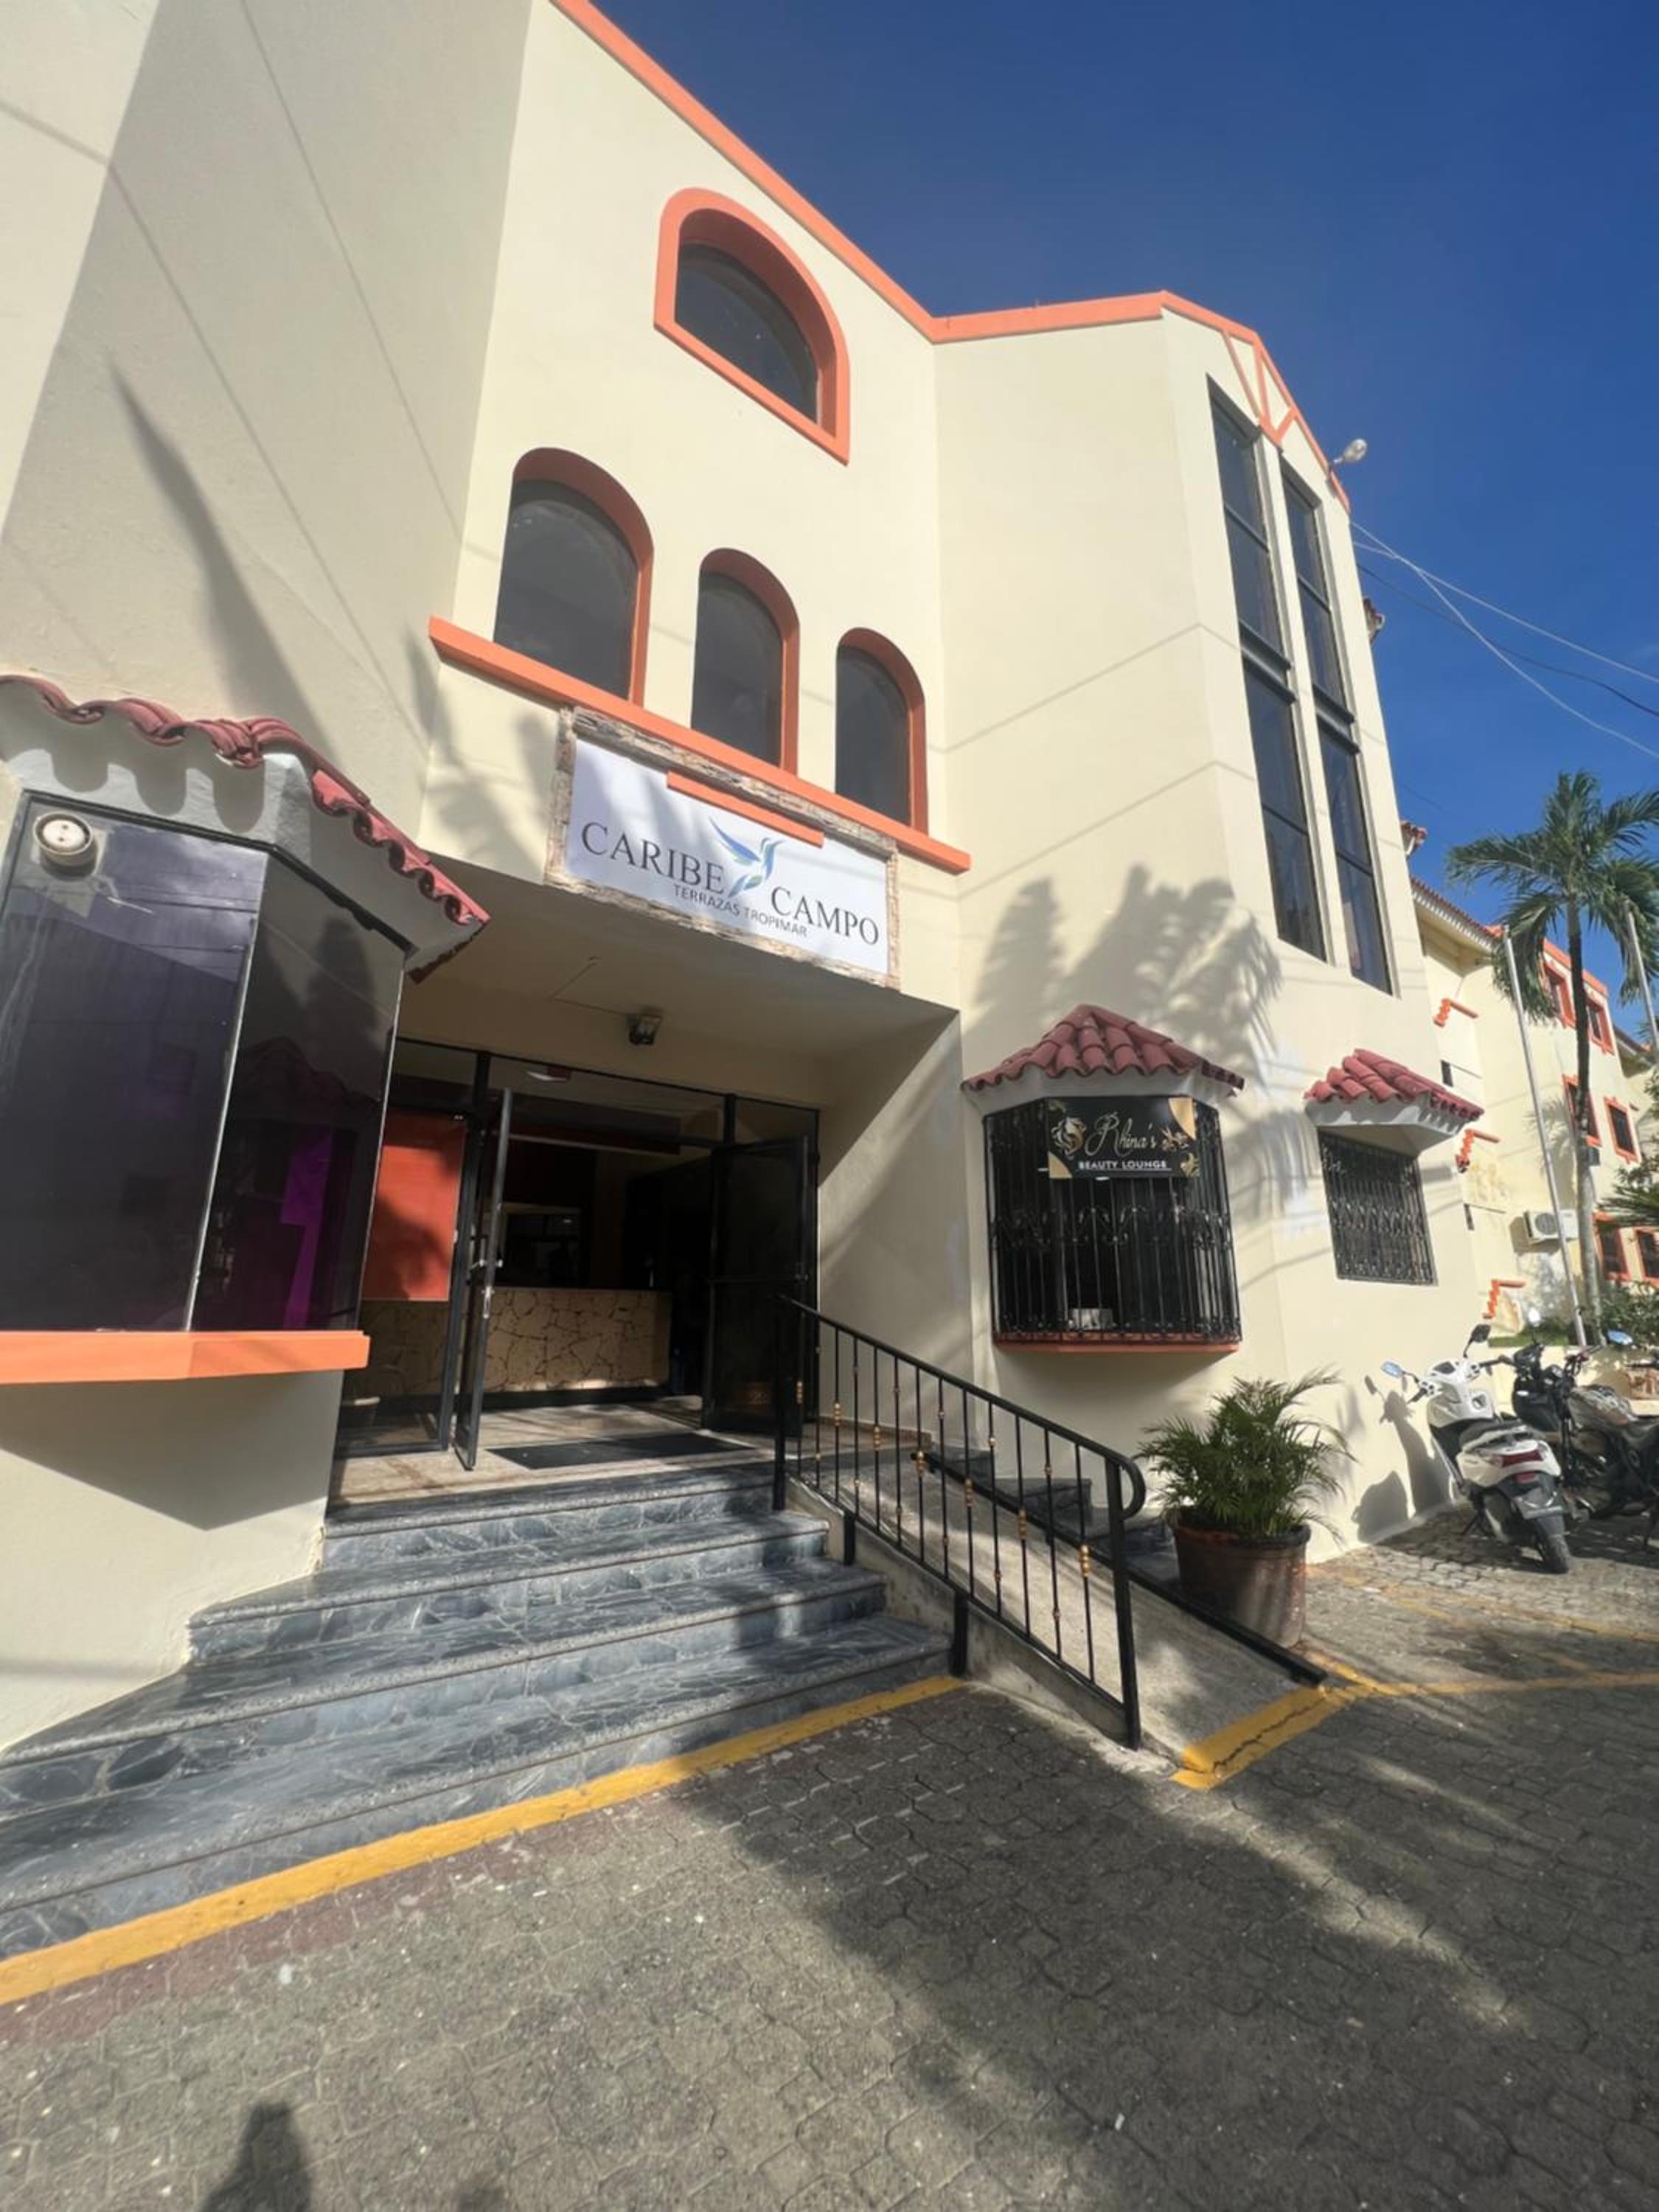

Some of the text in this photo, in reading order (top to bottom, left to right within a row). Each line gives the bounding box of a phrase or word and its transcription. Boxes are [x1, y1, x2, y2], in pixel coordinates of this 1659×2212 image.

[581, 821, 880, 945] CARIBE CAMPO
[674, 884, 808, 937] TERRAZAS TROPIMAR
[1078, 1159, 1167, 1170] BEAUTY LOUNGE
